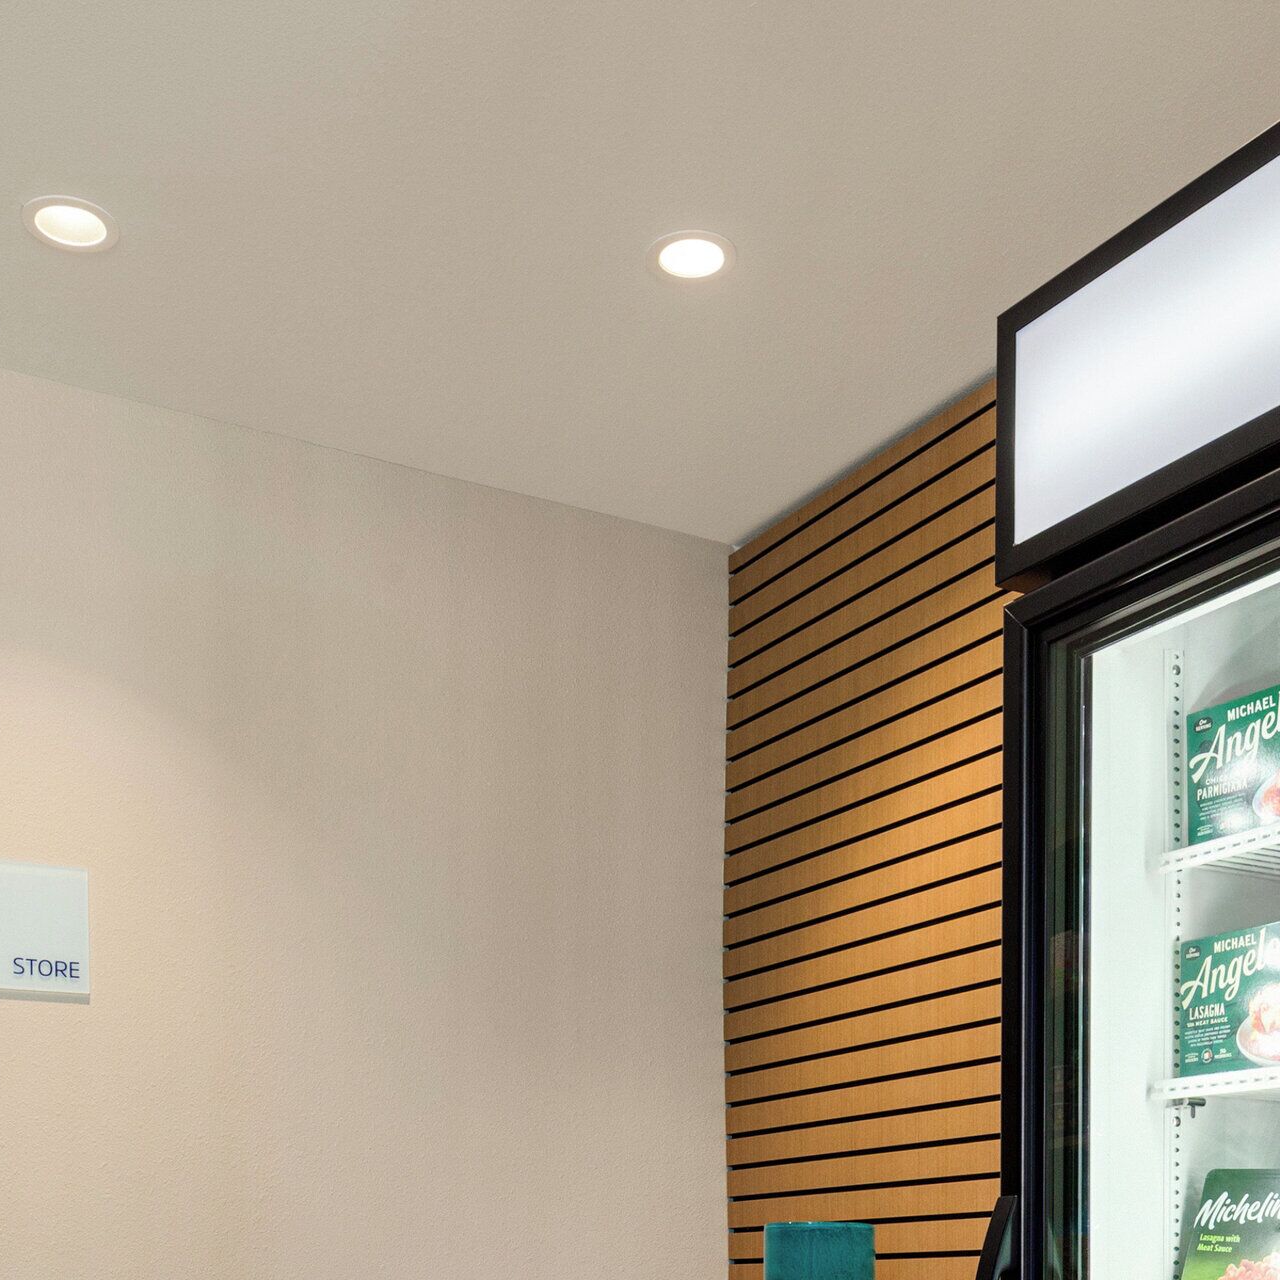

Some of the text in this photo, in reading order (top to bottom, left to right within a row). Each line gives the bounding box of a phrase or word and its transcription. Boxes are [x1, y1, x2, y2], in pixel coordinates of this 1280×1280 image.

[1227, 695, 1276, 722] MICHAEL
[1214, 933, 1257, 954] MICHAEL
[13, 957, 80, 979] STORE
[1189, 1002, 1225, 1021] LASAGNA
[1197, 1243, 1233, 1253] Meat Sauce
[1199, 1233, 1241, 1244] Lasagna with
